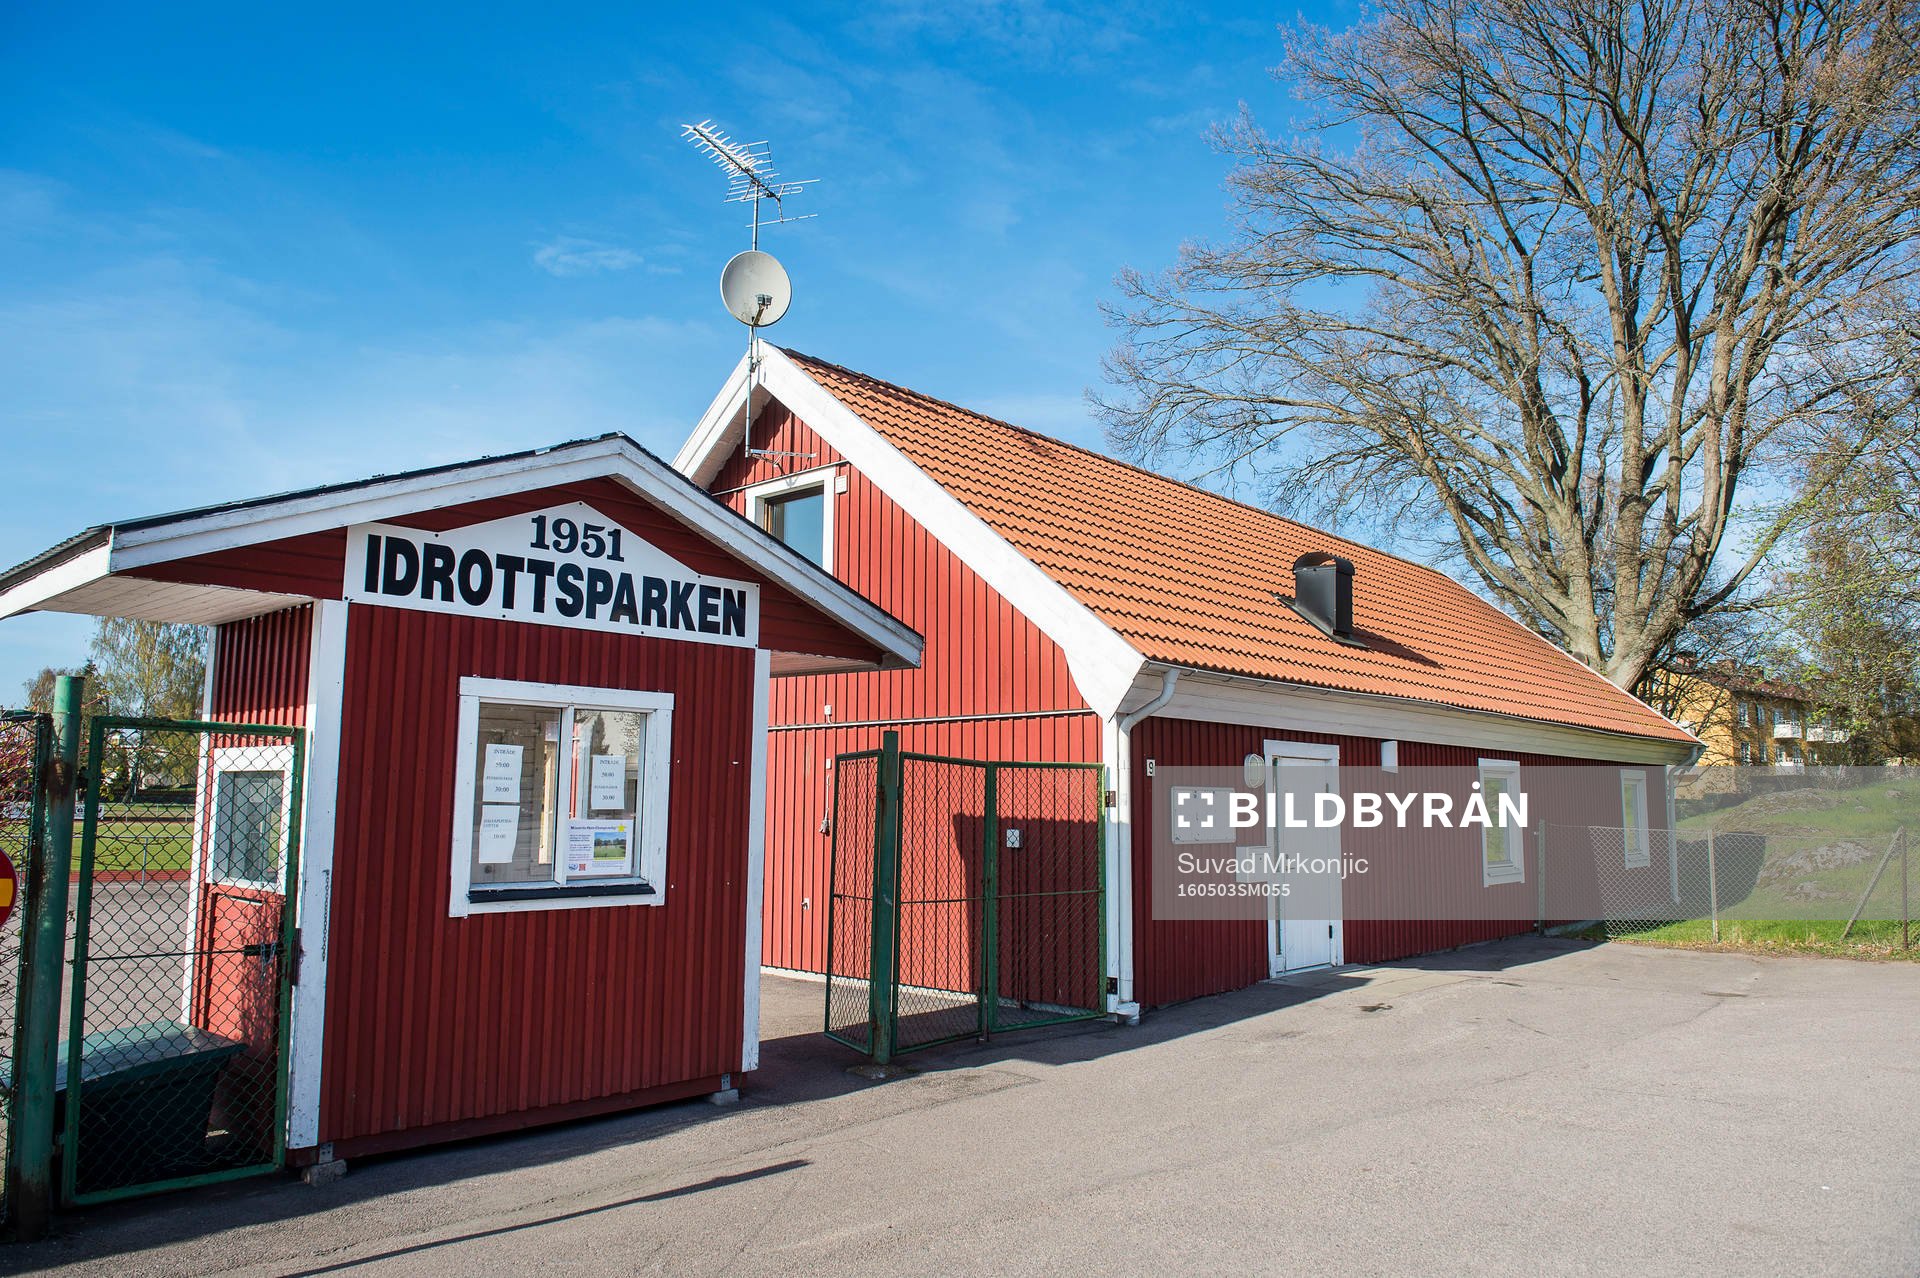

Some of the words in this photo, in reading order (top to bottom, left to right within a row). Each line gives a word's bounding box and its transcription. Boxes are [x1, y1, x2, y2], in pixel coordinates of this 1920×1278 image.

[530, 515, 624, 562] 1951
[364, 534, 746, 637] IDROTTSPARKEN
[1148, 761, 1154, 775] 9
